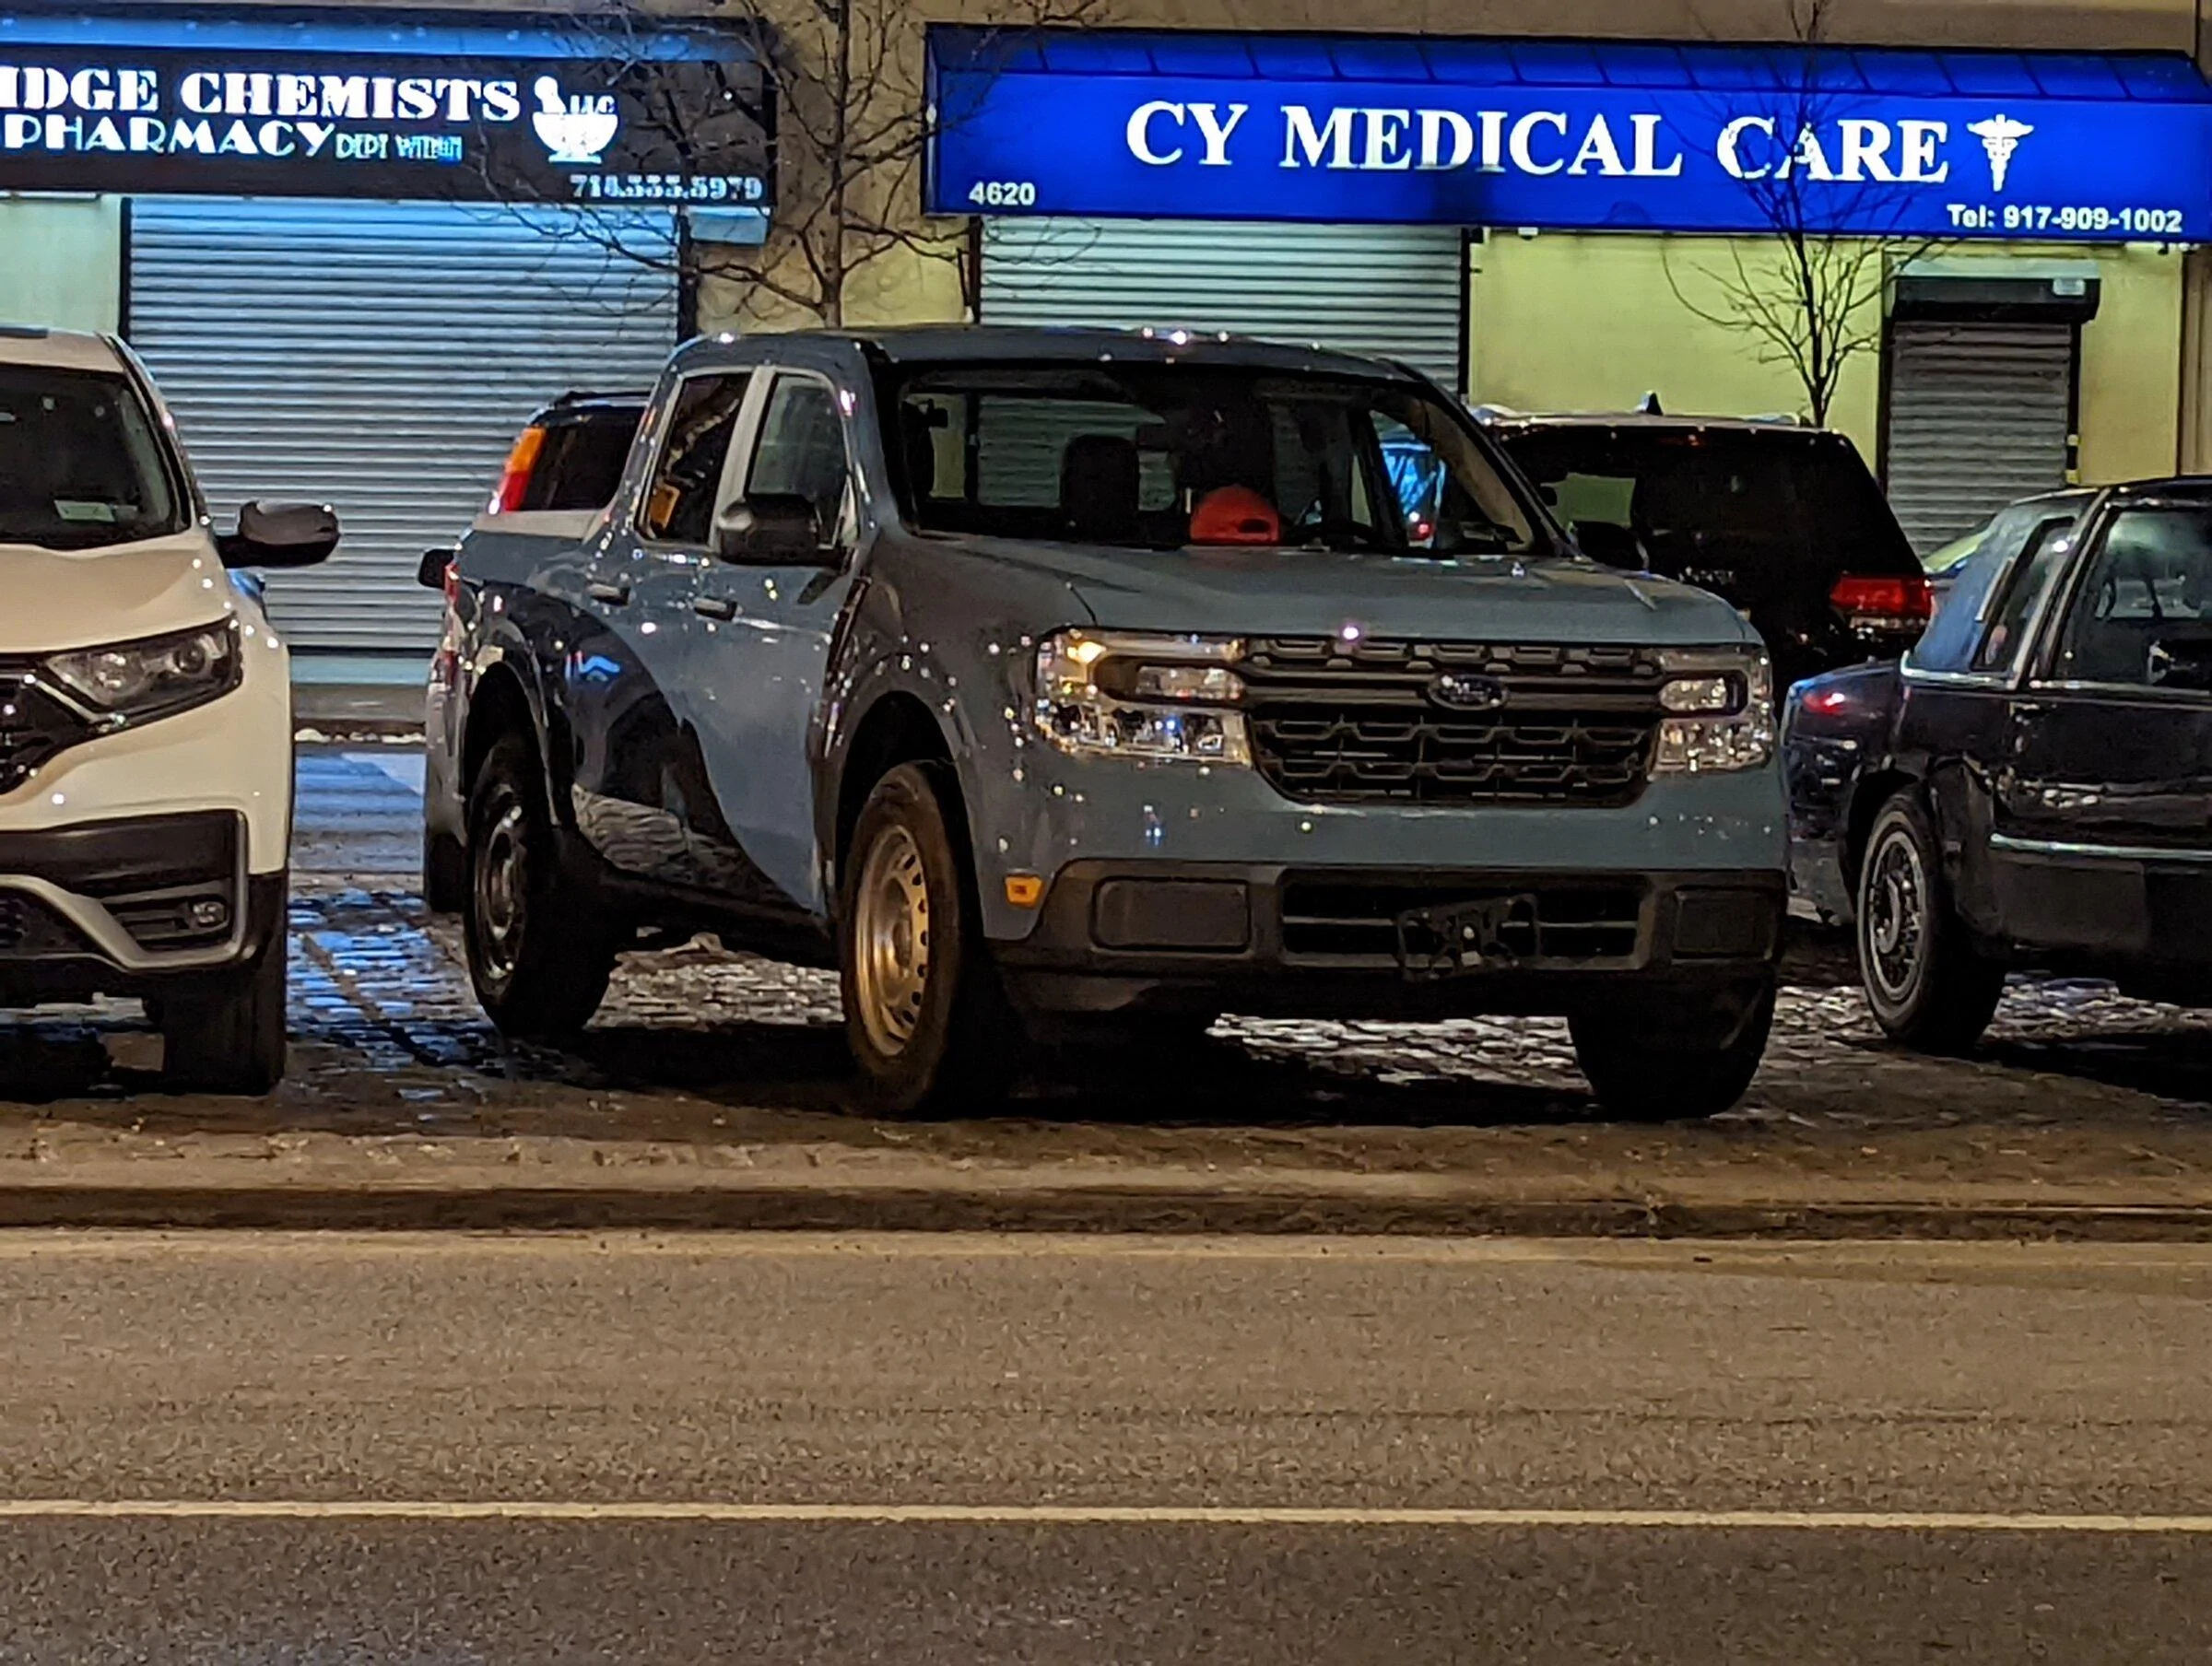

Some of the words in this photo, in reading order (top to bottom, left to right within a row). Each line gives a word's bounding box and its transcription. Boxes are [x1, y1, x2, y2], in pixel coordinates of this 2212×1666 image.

[0, 65, 159, 111] IDGE
[181, 73, 521, 122] CHEMISTS
[5, 113, 335, 157] PHARMACY
[1126, 100, 1248, 167] CY
[1279, 105, 1683, 176] MEDICAL
[1717, 116, 1948, 182] CARE
[968, 181, 1036, 205] 4620
[1947, 204, 1995, 228] Tel:
[2004, 205, 2183, 233] 917-909-1002
